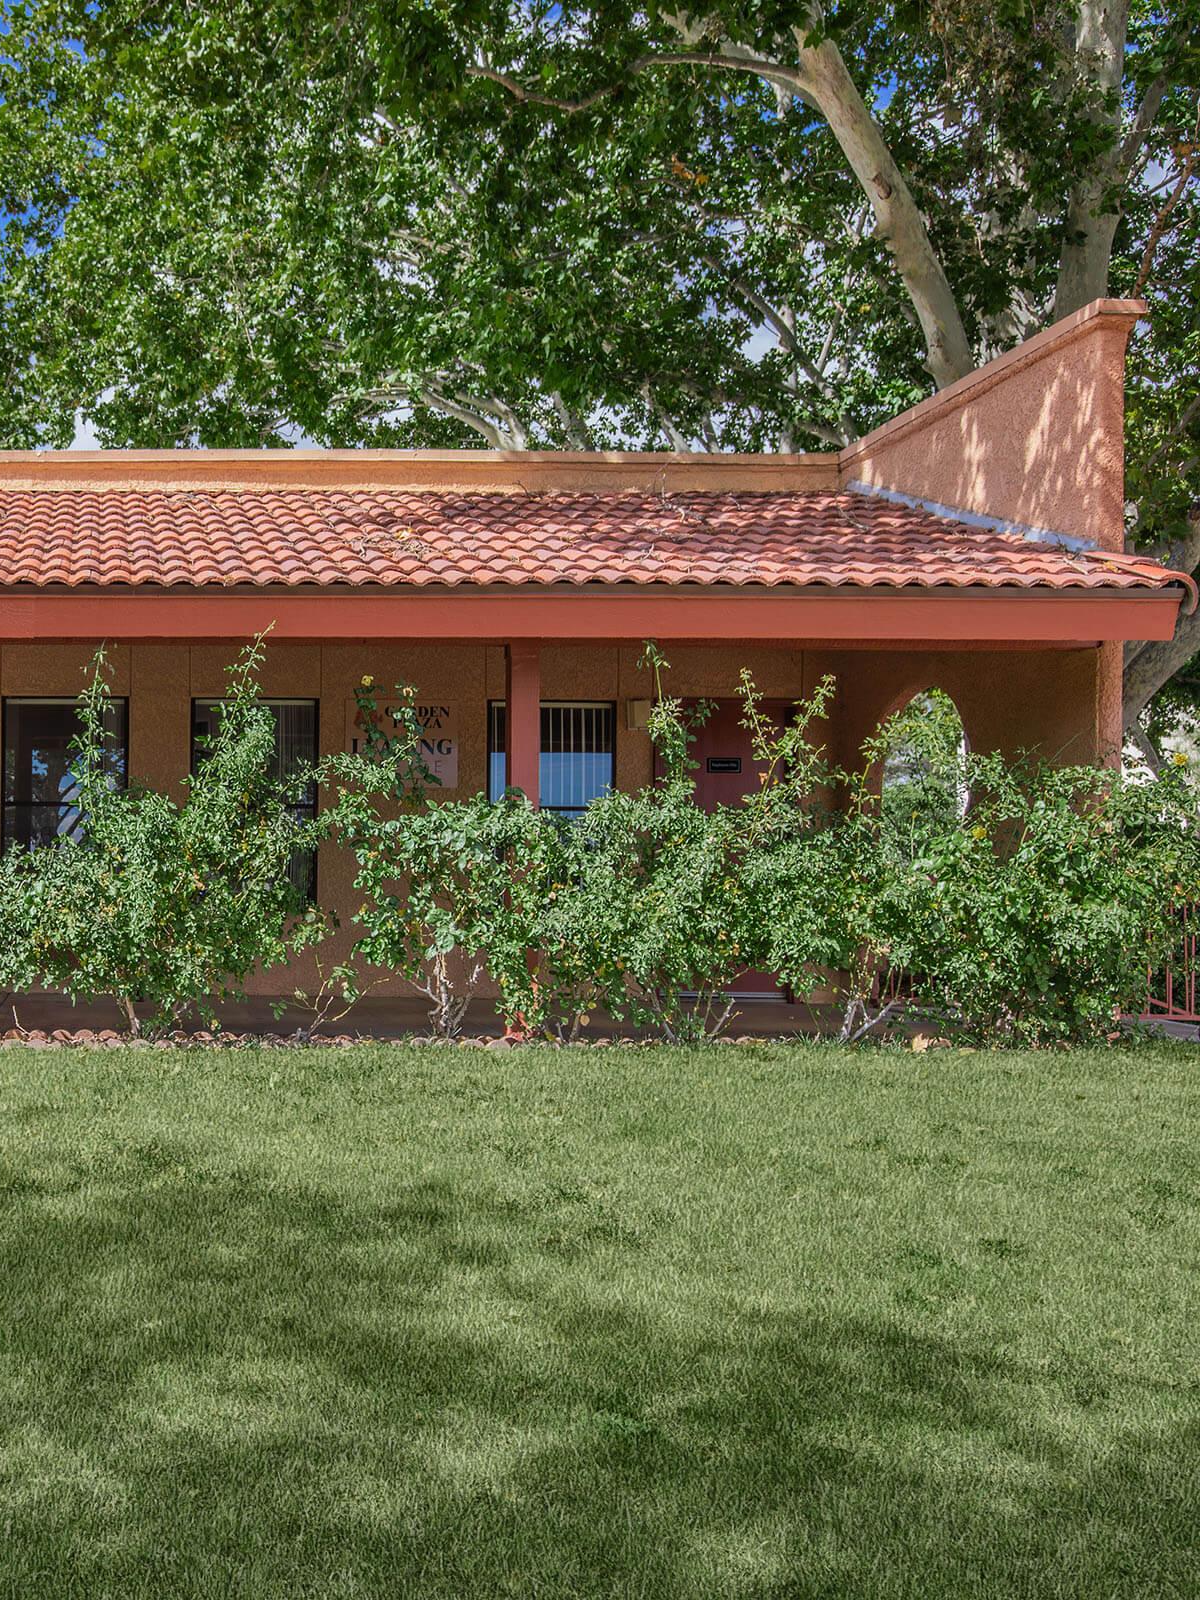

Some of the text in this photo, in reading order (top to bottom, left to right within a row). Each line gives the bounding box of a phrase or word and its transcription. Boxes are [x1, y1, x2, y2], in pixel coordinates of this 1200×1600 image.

[384, 705, 450, 717] GDEN
[393, 718, 442, 729] PZA
[352, 739, 452, 755] LANG
